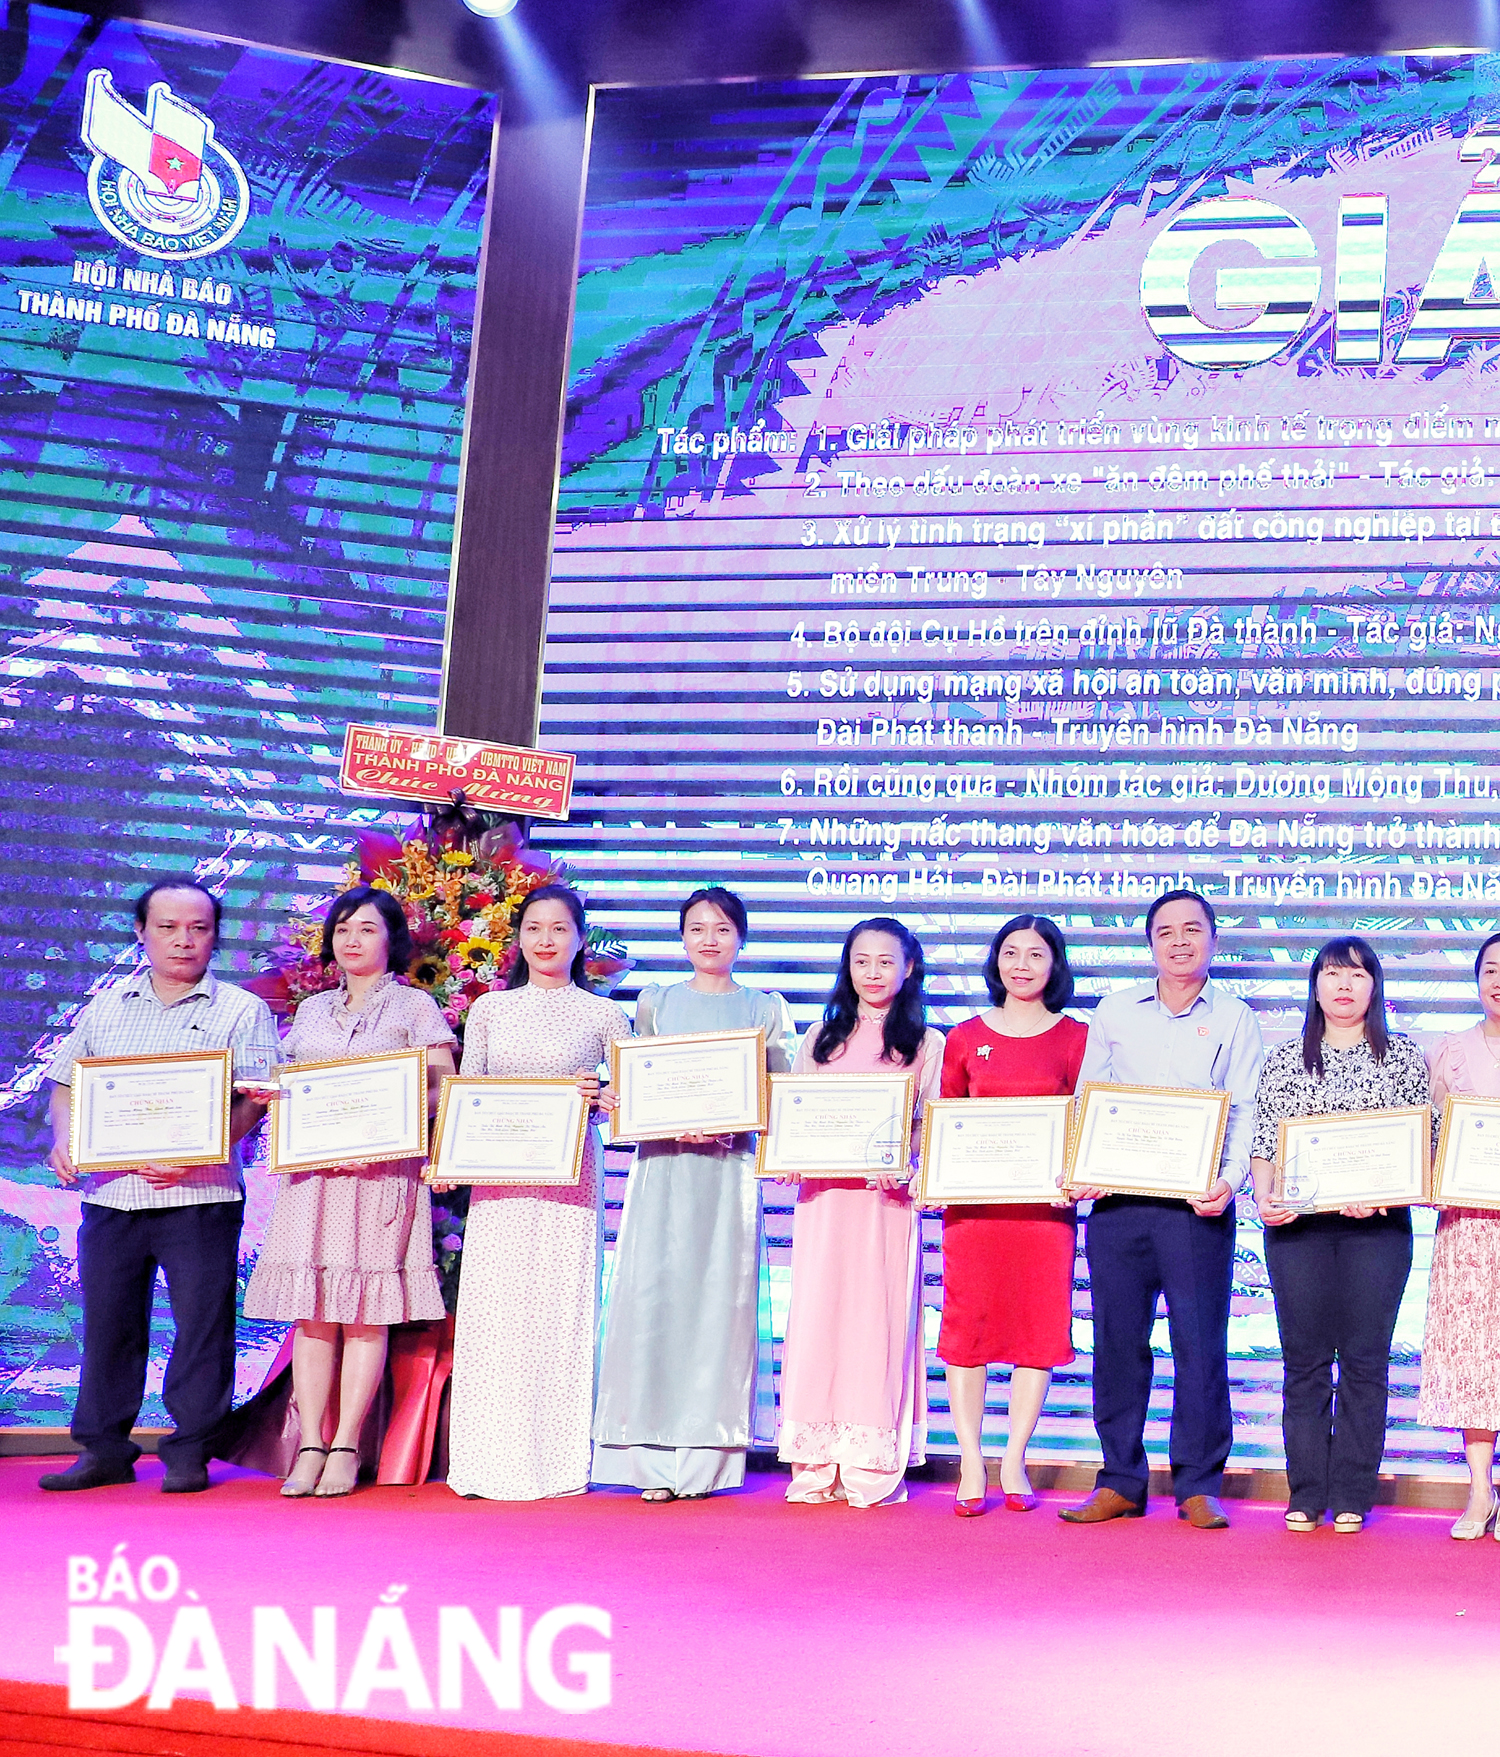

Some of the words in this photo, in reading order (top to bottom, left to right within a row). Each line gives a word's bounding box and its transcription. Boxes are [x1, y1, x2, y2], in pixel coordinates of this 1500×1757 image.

[72, 260, 116, 291] HỘI
[123, 268, 175, 297] NHÀ
[182, 276, 232, 305] BÁO
[19, 290, 103, 323] THÀNH
[110, 303, 162, 332] PHỐ
[166, 310, 199, 338] ĐÀ
[207, 314, 276, 349] NẴNG
[801, 520, 823, 546] 3.
[879, 519, 900, 551] lý
[909, 517, 962, 544] tình
[973, 519, 1045, 549] trạng
[1253, 511, 1324, 545] công
[1334, 511, 1434, 544] nghiệp
[1445, 510, 1481, 543] tại
[790, 622, 811, 647] 4.
[822, 621, 861, 653] Bộ
[869, 620, 911, 653] đội
[921, 621, 958, 653] Cụ
[968, 616, 1006, 645] Hồ
[1015, 619, 1068, 645] trên
[1079, 614, 1141, 645] đỉnh
[1153, 617, 1177, 644] lũ
[1186, 618, 1225, 643] Đà
[1235, 617, 1317, 644] thành
[1348, 616, 1399, 643] Tác
[1409, 613, 1462, 650] giả:
[787, 671, 809, 697] 5.
[819, 666, 857, 696] Sử
[864, 671, 933, 702] dụng
[943, 672, 1022, 701] mạng
[1031, 671, 1062, 695] xã
[1073, 667, 1115, 700] hội
[1126, 675, 1161, 695] an
[1170, 667, 1241, 699] toàn,
[1252, 667, 1311, 694] văn
[1314, 667, 1395, 697] minh,
[1406, 666, 1481, 701] đúng
[817, 718, 861, 745] Đài
[872, 717, 934, 745] Phát
[943, 718, 1022, 745] thanh
[1051, 714, 1149, 752] Truyền
[1160, 717, 1223, 746] hình
[1233, 716, 1273, 745] Đà
[1282, 711, 1359, 752] Nẵng
[353, 752, 419, 772] THÀNH
[472, 768, 500, 783] ĐÀ
[506, 772, 563, 791] NẴNG
[356, 734, 388, 751] THÀNH
[546, 762, 567, 777] NAM
[355, 768, 438, 790] Chúc
[780, 769, 803, 796] 6.
[814, 763, 858, 796] Rồi
[867, 767, 936, 802] cũng
[946, 774, 997, 802] qua
[1026, 767, 1108, 797] Nhóm
[1118, 768, 1162, 796] tác
[1171, 763, 1224, 802] giả:
[1235, 768, 1330, 802] Dương
[1342, 769, 1423, 803] Mộng
[1434, 769, 1498, 801] Thu,
[777, 819, 799, 846] 7.
[809, 818, 901, 852] Những
[911, 814, 961, 846] nấc
[971, 818, 1051, 854] thang
[1061, 818, 1111, 847] văn
[1122, 817, 1174, 847] hóa
[1184, 812, 1220, 848] để
[1229, 818, 1267, 848] Đà
[1278, 813, 1355, 854] Nẵng
[1365, 816, 1407, 849] trở
[1416, 816, 1500, 850] thành
